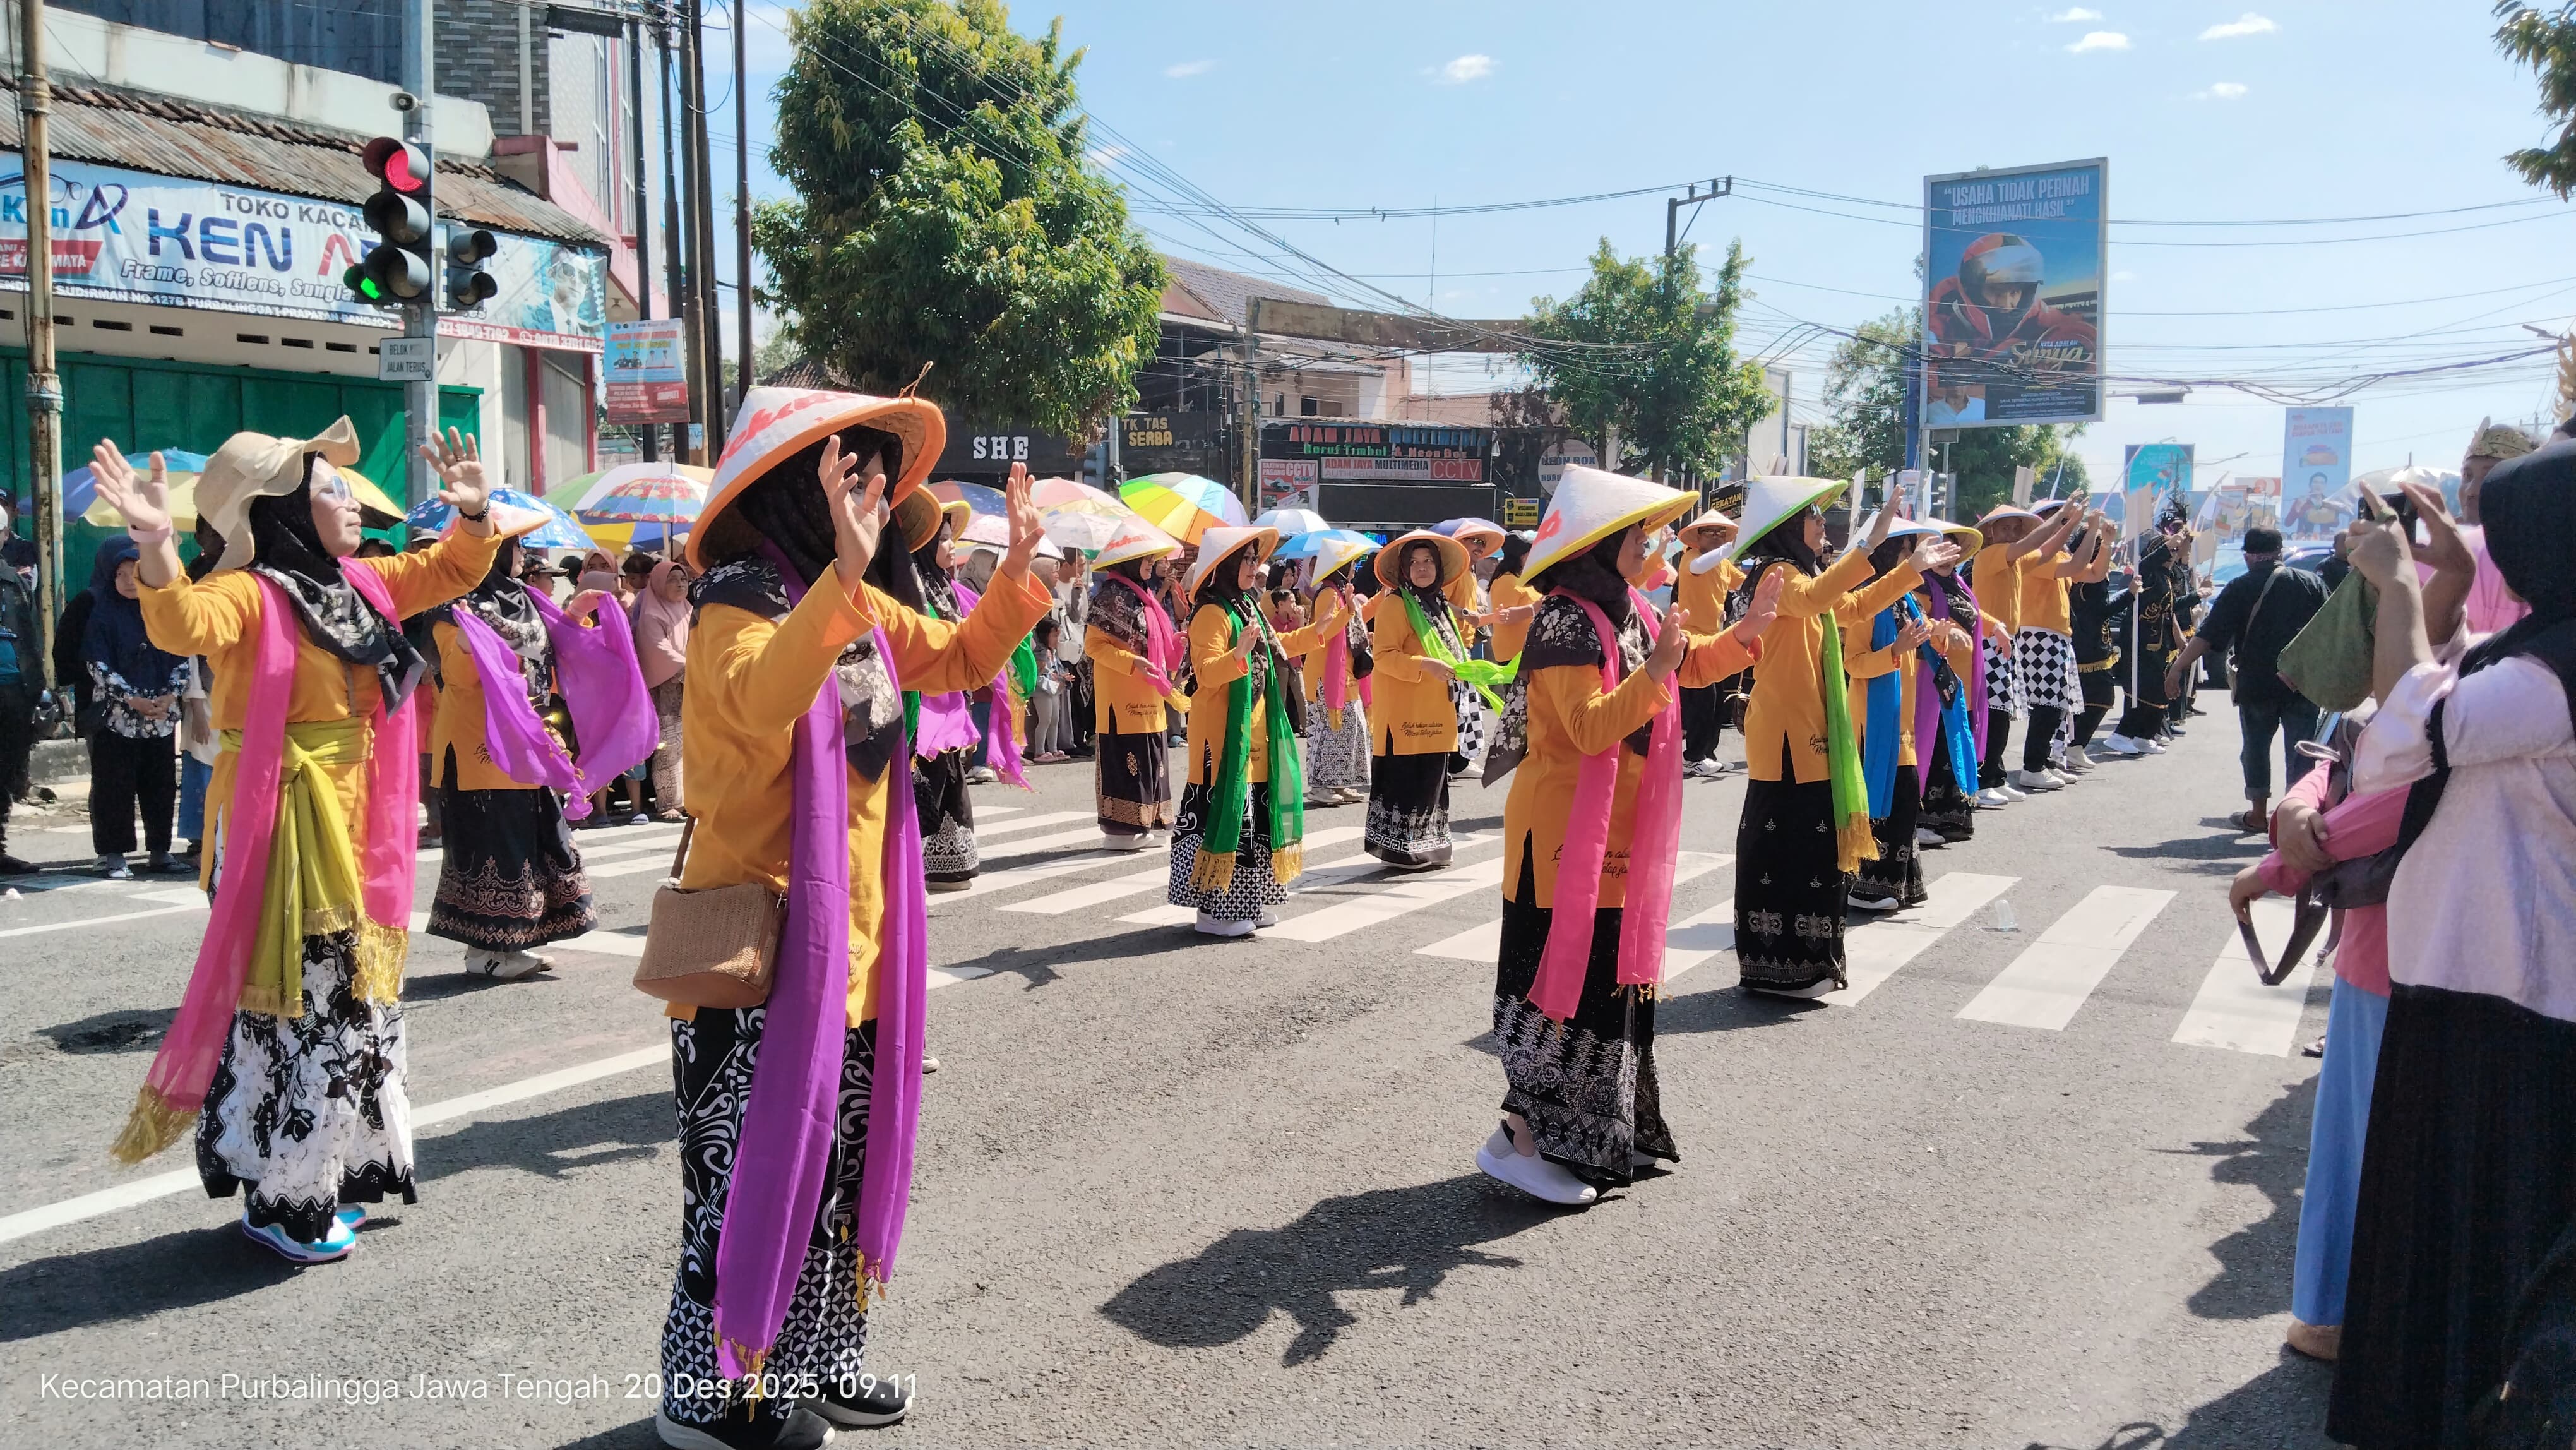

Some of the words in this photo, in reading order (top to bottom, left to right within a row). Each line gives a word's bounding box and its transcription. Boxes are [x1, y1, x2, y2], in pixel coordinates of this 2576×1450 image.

[1997, 180, 2035, 203] TIDAK
[2038, 174, 2090, 199] PERNAH
[220, 193, 290, 219] TOKO
[1952, 202, 2032, 226] MENGKHIANATI
[148, 208, 293, 273] KEN
[121, 259, 194, 286] Frame,
[200, 268, 285, 297] Softlens,
[389, 344, 408, 355] BELOK
[386, 361, 405, 373] JALAN
[405, 361, 426, 373] TERUS
[1121, 418, 1138, 431] TK
[1143, 417, 1168, 431] TAS
[973, 436, 1029, 460] SHE
[1128, 431, 1172, 446] SERBA
[1285, 462, 1315, 476] CCTV
[1325, 459, 1351, 469] ADAM
[1353, 460, 1373, 469] JAYA
[1374, 460, 1429, 470] MULTIMEDIA
[1433, 460, 1481, 479] CCTV
[1541, 456, 1570, 465] NEON
[1573, 456, 1595, 465] BOX
